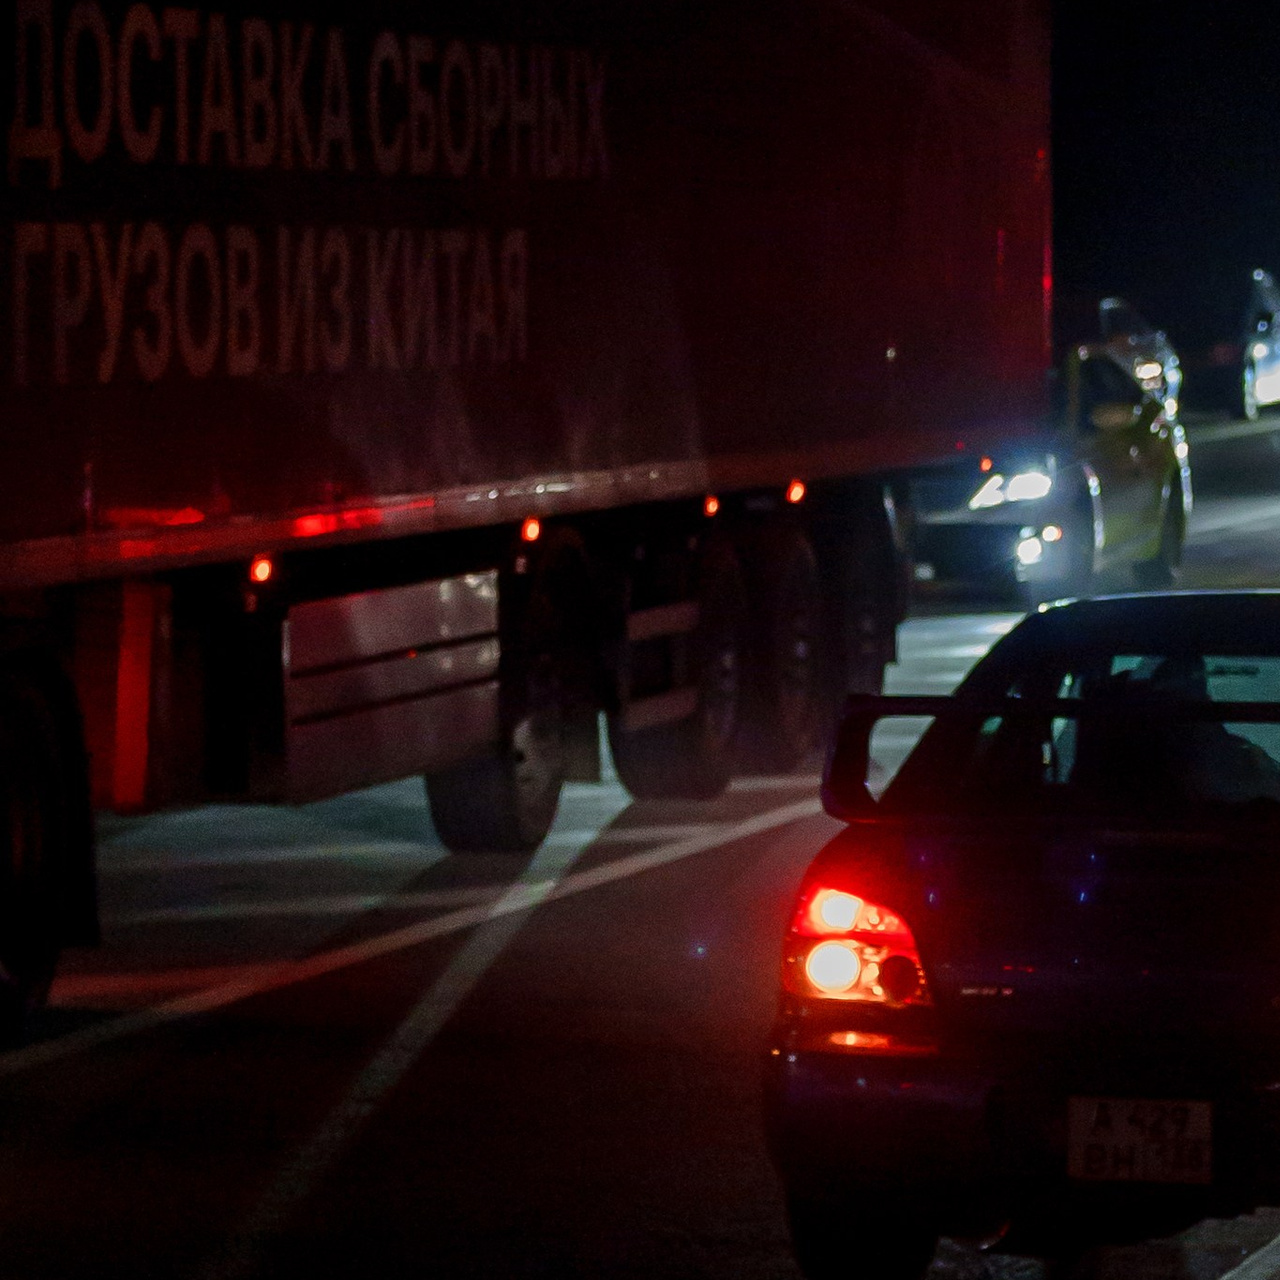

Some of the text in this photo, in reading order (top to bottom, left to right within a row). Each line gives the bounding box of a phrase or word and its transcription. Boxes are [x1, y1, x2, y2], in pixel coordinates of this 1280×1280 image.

[369, 30, 608, 179] СБОРНЫХ
[12, 221, 528, 386] ГРУЗОВ ИЗ КИТАЯ
